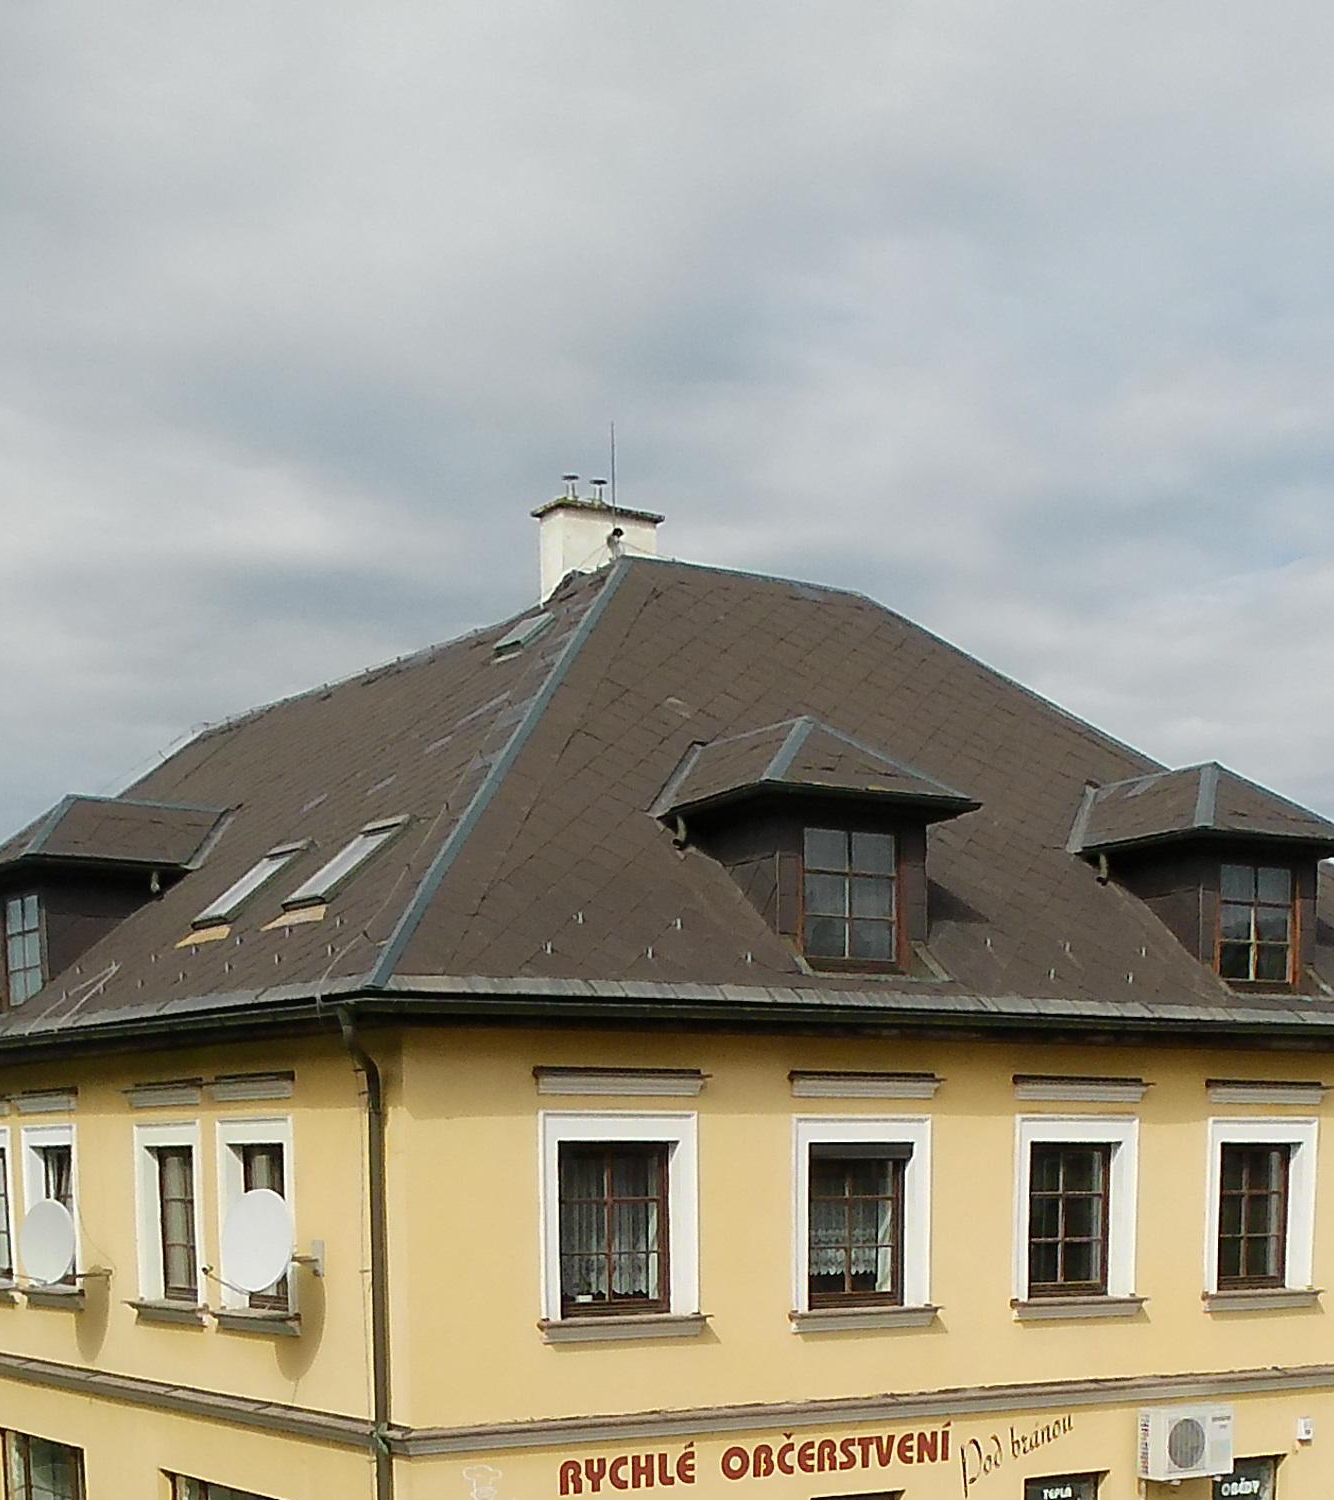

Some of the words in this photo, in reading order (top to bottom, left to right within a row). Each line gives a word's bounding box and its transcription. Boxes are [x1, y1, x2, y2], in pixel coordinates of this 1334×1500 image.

[559, 1441, 696, 1496] RYCHLÉ
[721, 1421, 952, 1480] OBČERSTVENÍ
[960, 1434, 1003, 1499] Pod
[1009, 1414, 1074, 1459] bránou
